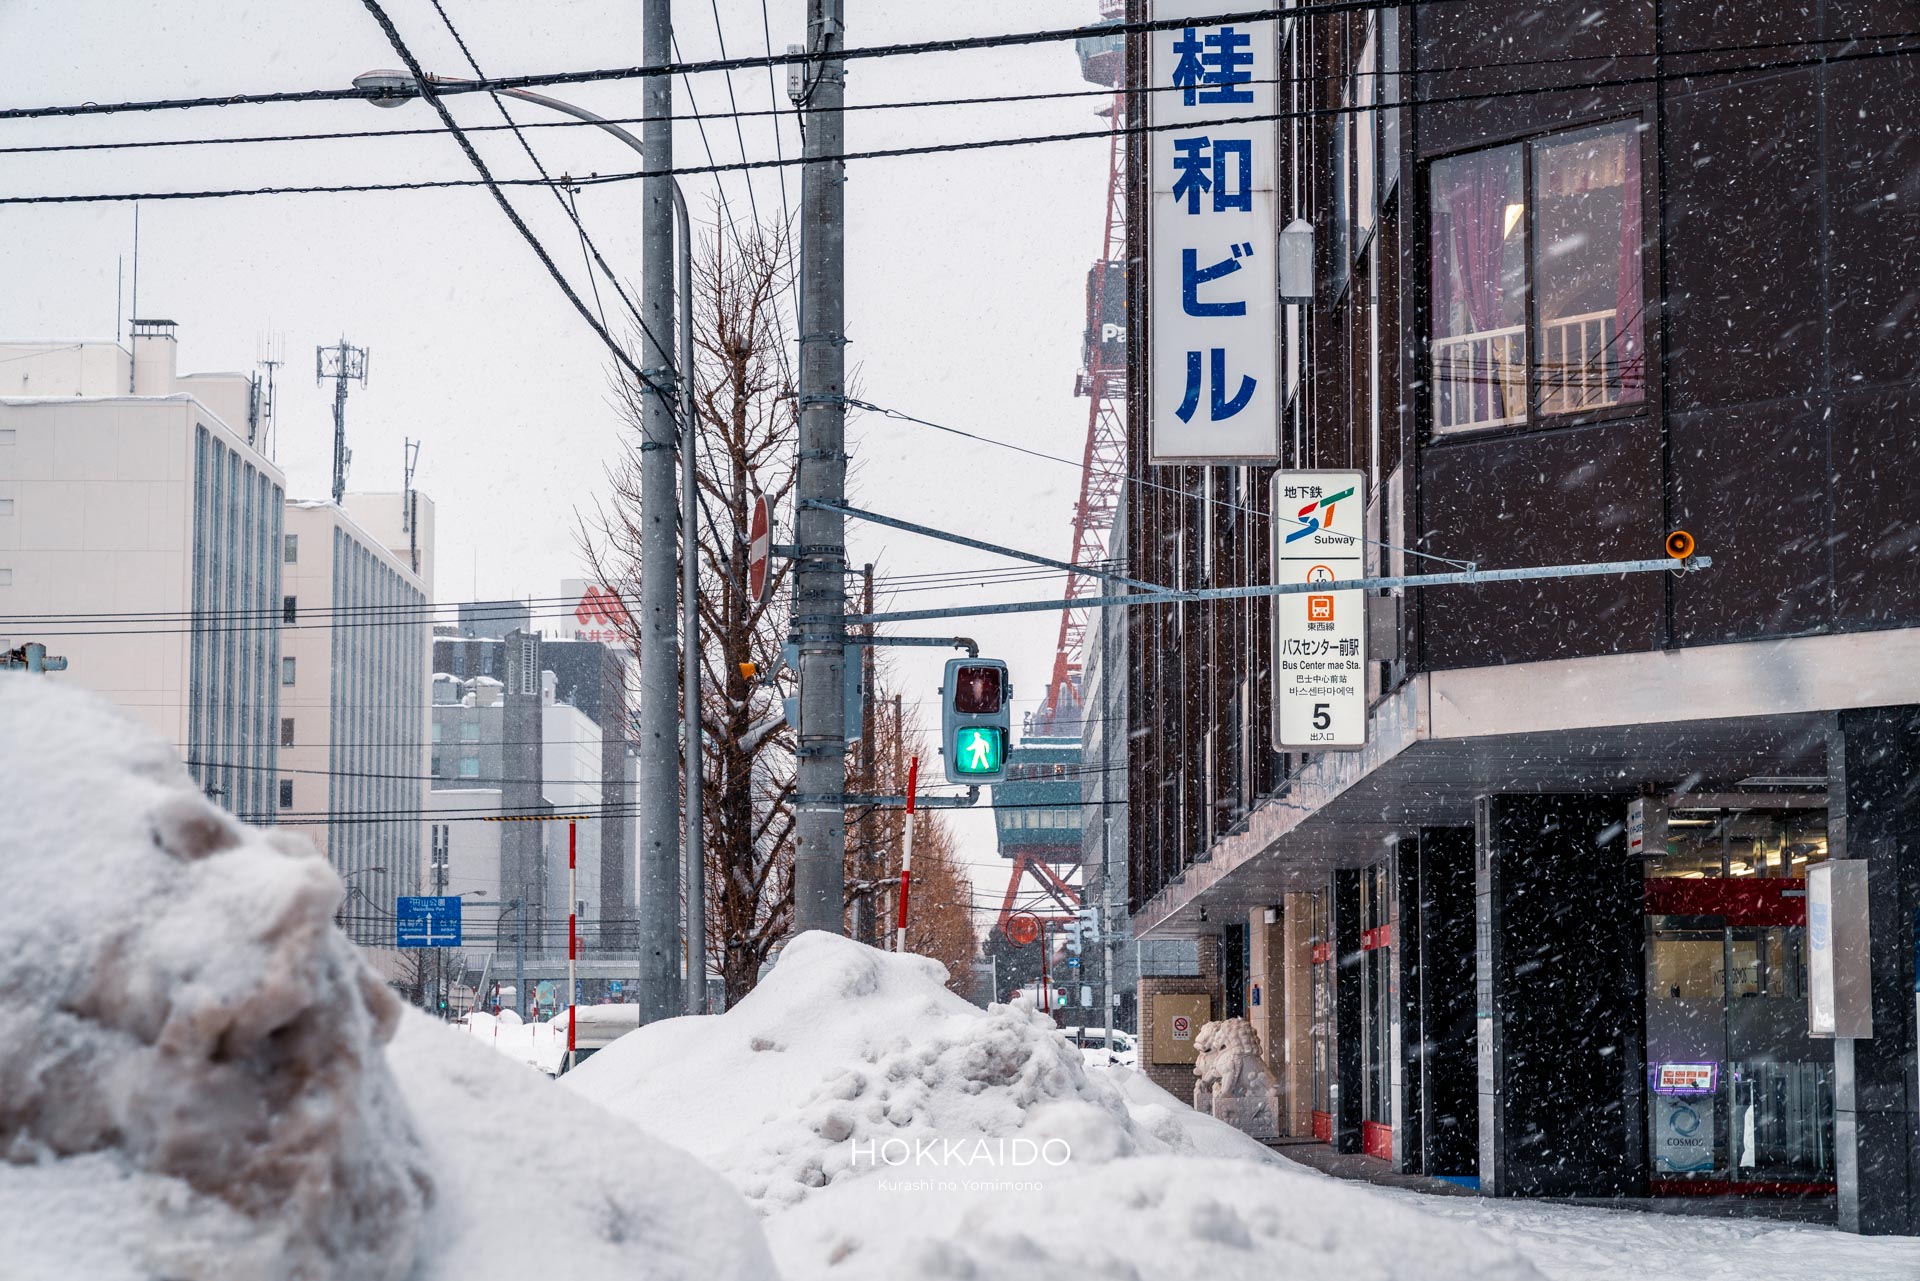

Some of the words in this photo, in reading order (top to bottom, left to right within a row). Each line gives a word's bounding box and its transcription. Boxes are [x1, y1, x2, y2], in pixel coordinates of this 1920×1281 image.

[1172, 27, 1258, 425] 桂和ビル
[1284, 486, 1323, 499] 地下鉄
[1314, 535, 1356, 547] Subway
[1307, 622, 1335, 632] 東西線
[1282, 638, 1359, 657] バスセンター前駅
[1282, 660, 1298, 670] Bus
[1300, 660, 1326, 670] Center
[1327, 662, 1345, 670] mae
[1346, 660, 1361, 670] Sta.
[1296, 674, 1348, 684] 巴士中心前站
[1289, 686, 1354, 697] 바스센타마에역
[1312, 703, 1331, 730] 5
[1310, 732, 1335, 741] 出入口
[1667, 1137, 1704, 1147] COSMOS
